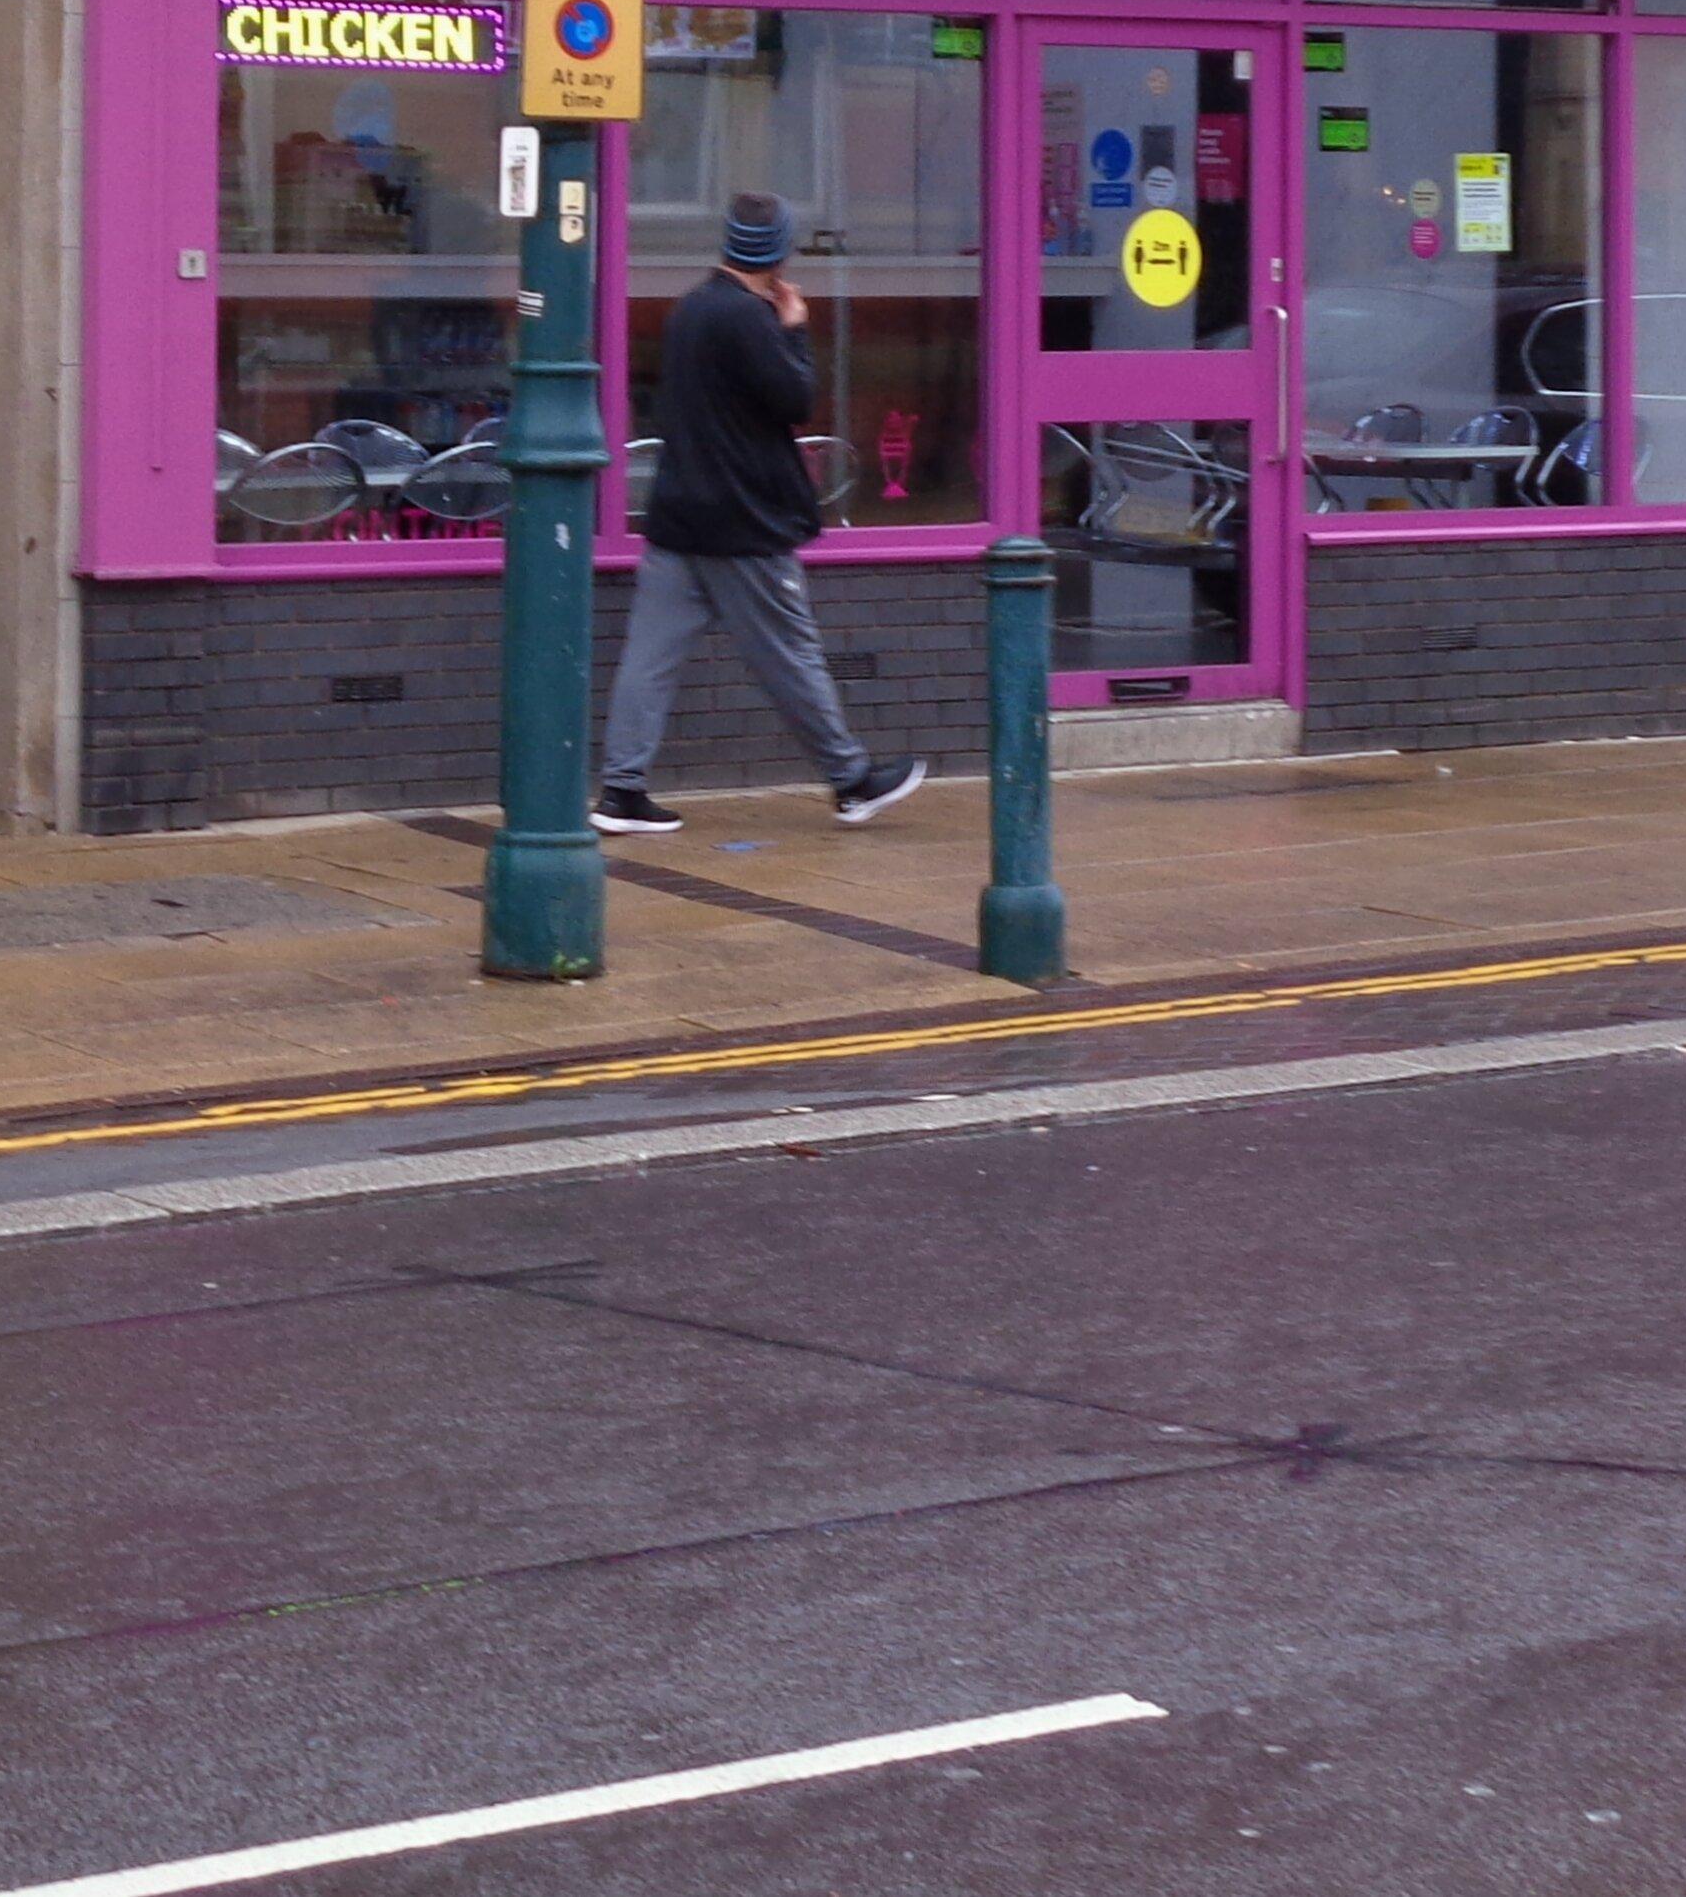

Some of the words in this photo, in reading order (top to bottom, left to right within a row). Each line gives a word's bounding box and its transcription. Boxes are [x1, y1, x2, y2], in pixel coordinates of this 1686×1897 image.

[226, 5, 474, 63] CHICKEN
[552, 67, 575, 86] At
[581, 72, 615, 90] any
[561, 90, 606, 109] time
